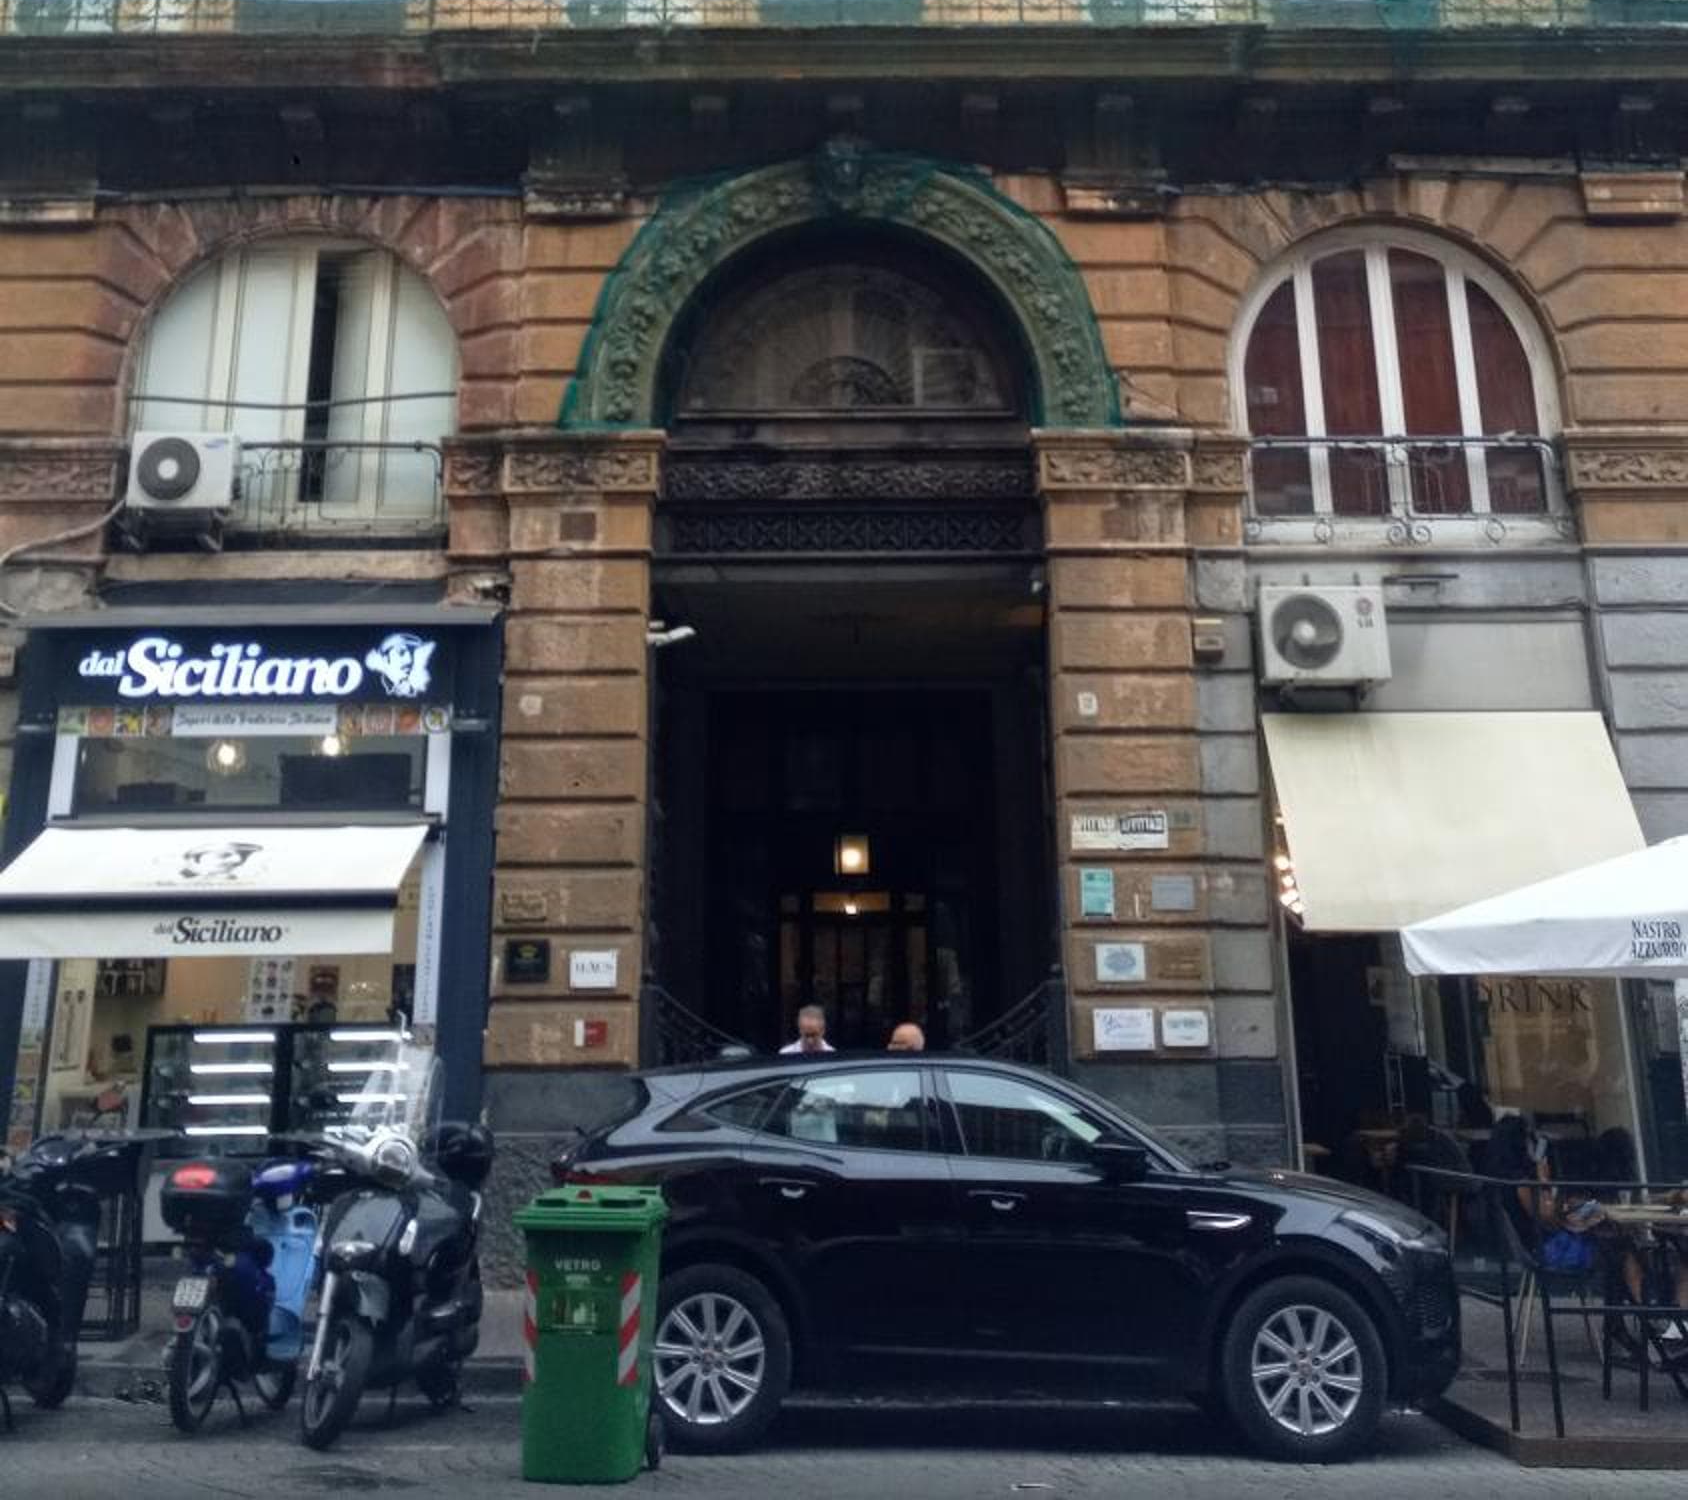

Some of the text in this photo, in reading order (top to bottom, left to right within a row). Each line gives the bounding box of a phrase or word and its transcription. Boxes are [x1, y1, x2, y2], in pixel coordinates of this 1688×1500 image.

[79, 637, 364, 697] dal Siciliano
[173, 916, 283, 944] Siciliano
[1631, 920, 1681, 939] NASTRO
[554, 1258, 602, 1272] VETRO
